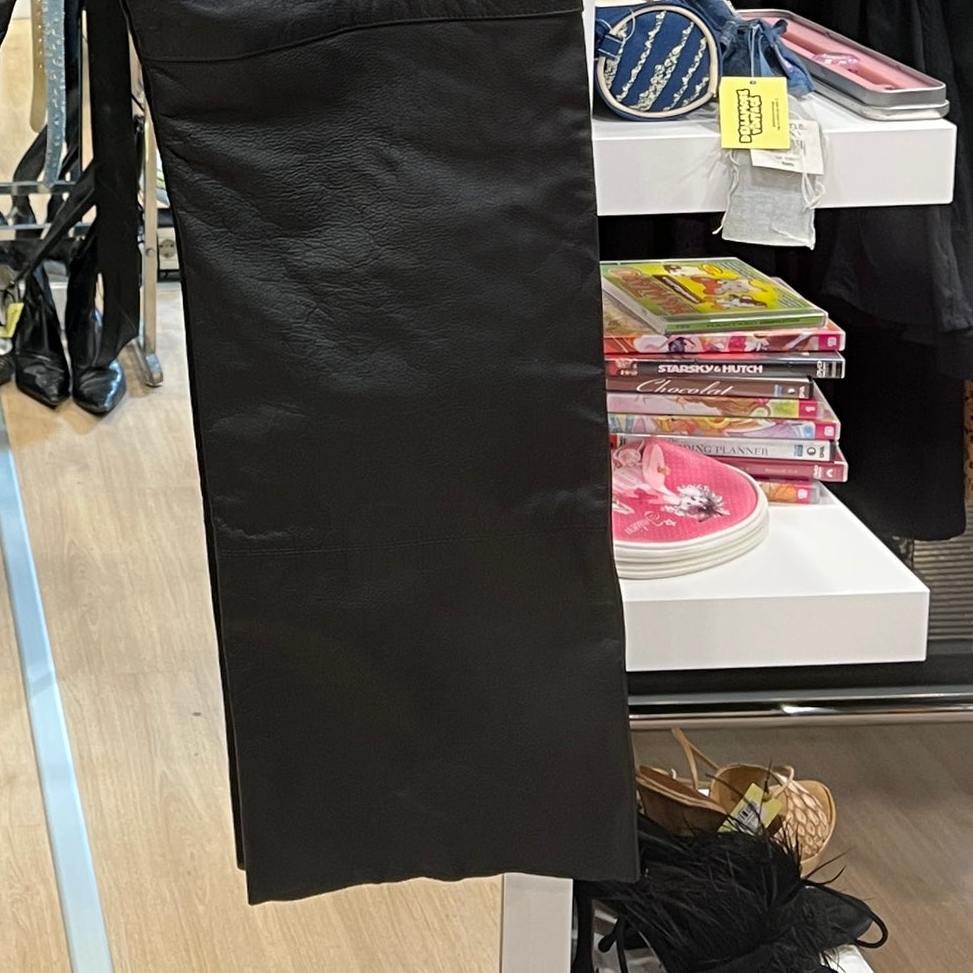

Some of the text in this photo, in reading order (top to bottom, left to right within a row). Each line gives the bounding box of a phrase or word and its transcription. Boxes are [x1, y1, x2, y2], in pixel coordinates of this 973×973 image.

[658, 364, 713, 374] STARSKY
[723, 365, 763, 374] HUTCH
[636, 379, 734, 396] Chocolat
[715, 445, 769, 456] PLANNER
